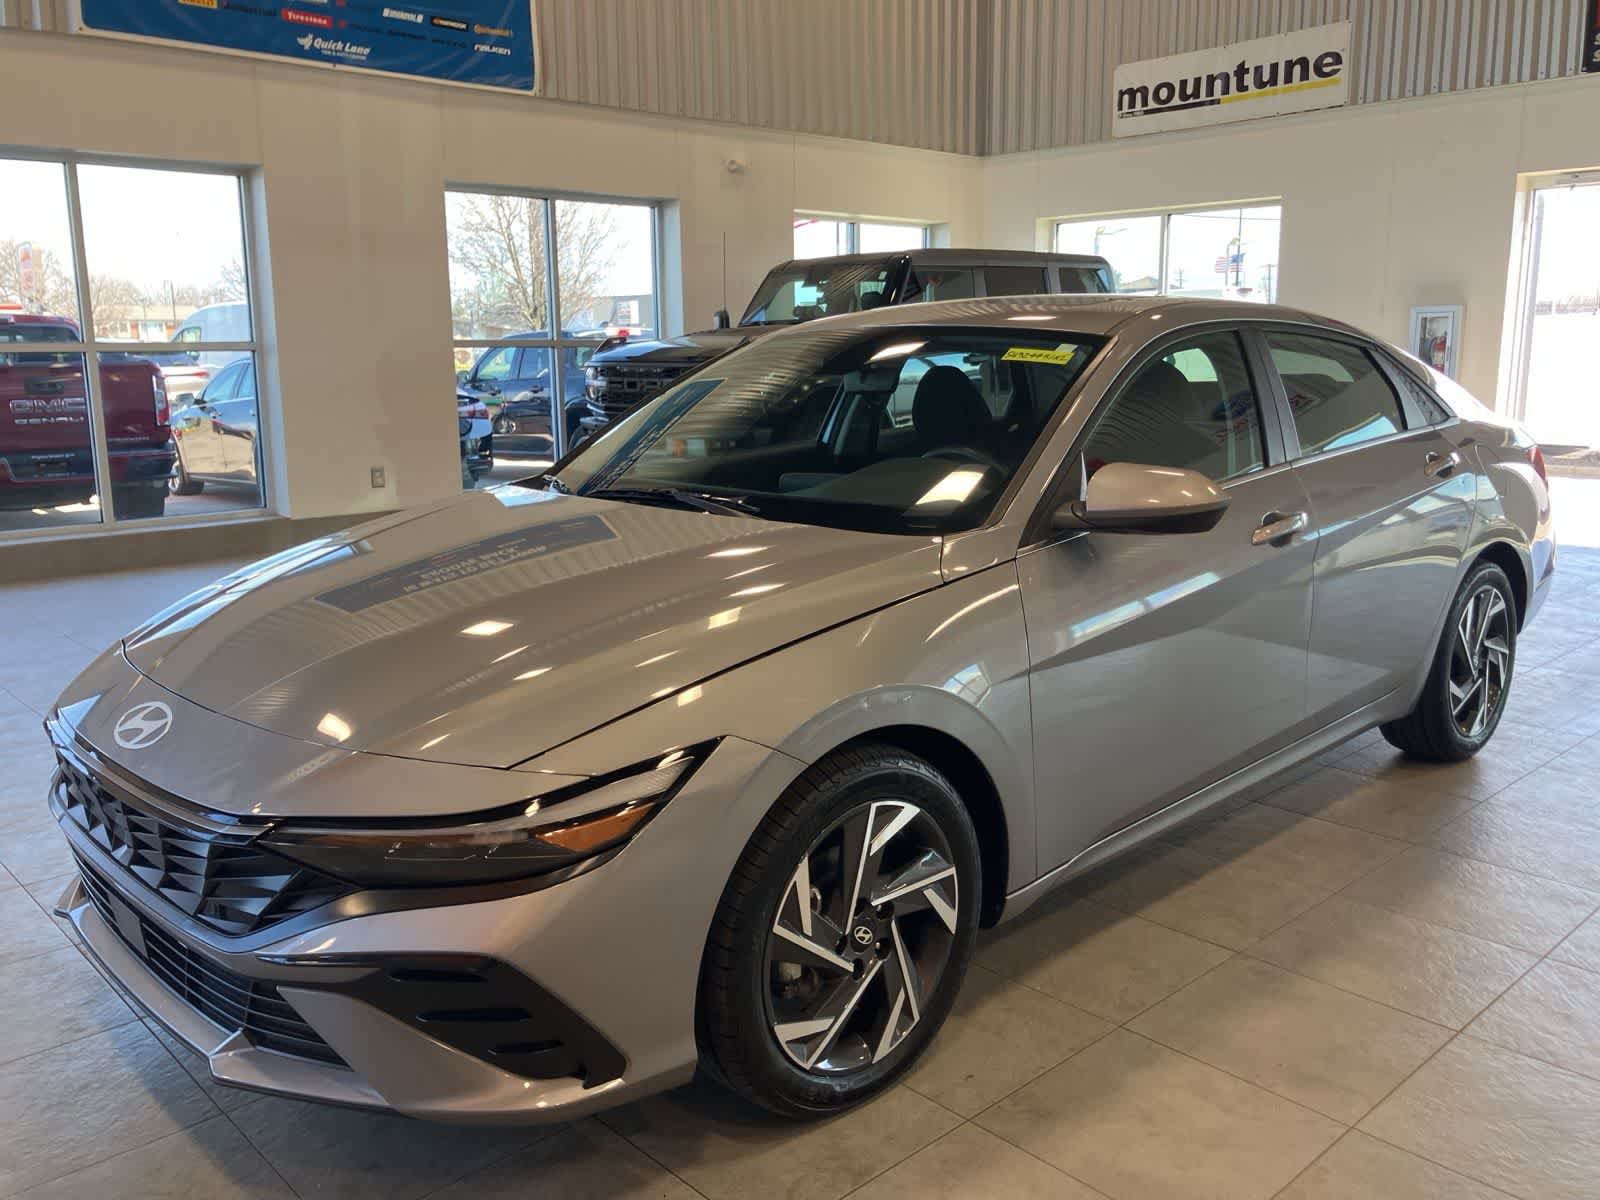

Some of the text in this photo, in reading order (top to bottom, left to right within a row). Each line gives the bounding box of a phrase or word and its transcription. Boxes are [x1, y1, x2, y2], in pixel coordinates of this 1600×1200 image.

[313, 37, 344, 52] Quick
[344, 41, 372, 55] Lane
[1116, 50, 1343, 112] mountune
[9, 397, 86, 414] GMC
[14, 416, 85, 425] DENALI
